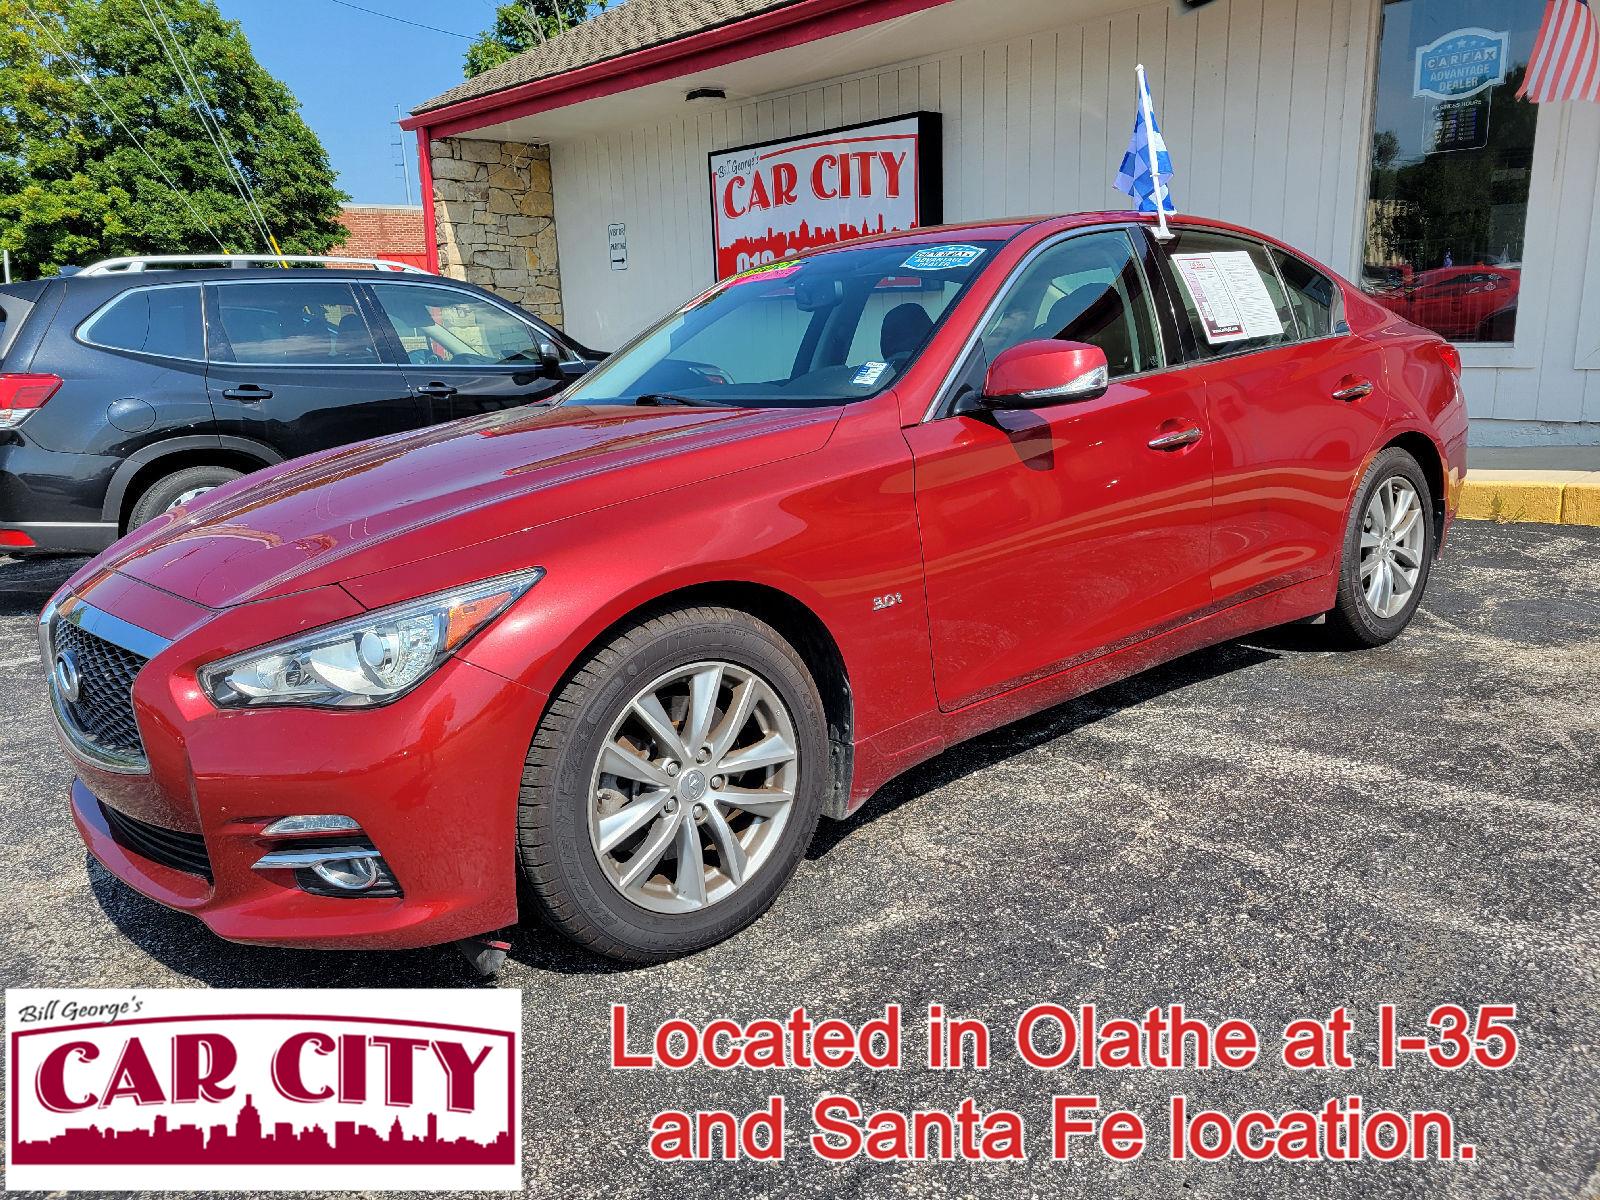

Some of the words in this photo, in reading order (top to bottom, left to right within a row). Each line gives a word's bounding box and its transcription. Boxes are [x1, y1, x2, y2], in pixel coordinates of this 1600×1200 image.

[1426, 50, 1498, 69] CARFAX
[1430, 64, 1490, 82] ADVANTAGE
[1439, 77, 1479, 92] DEALER
[723, 162, 798, 220] CAR
[810, 151, 906, 200] CITY
